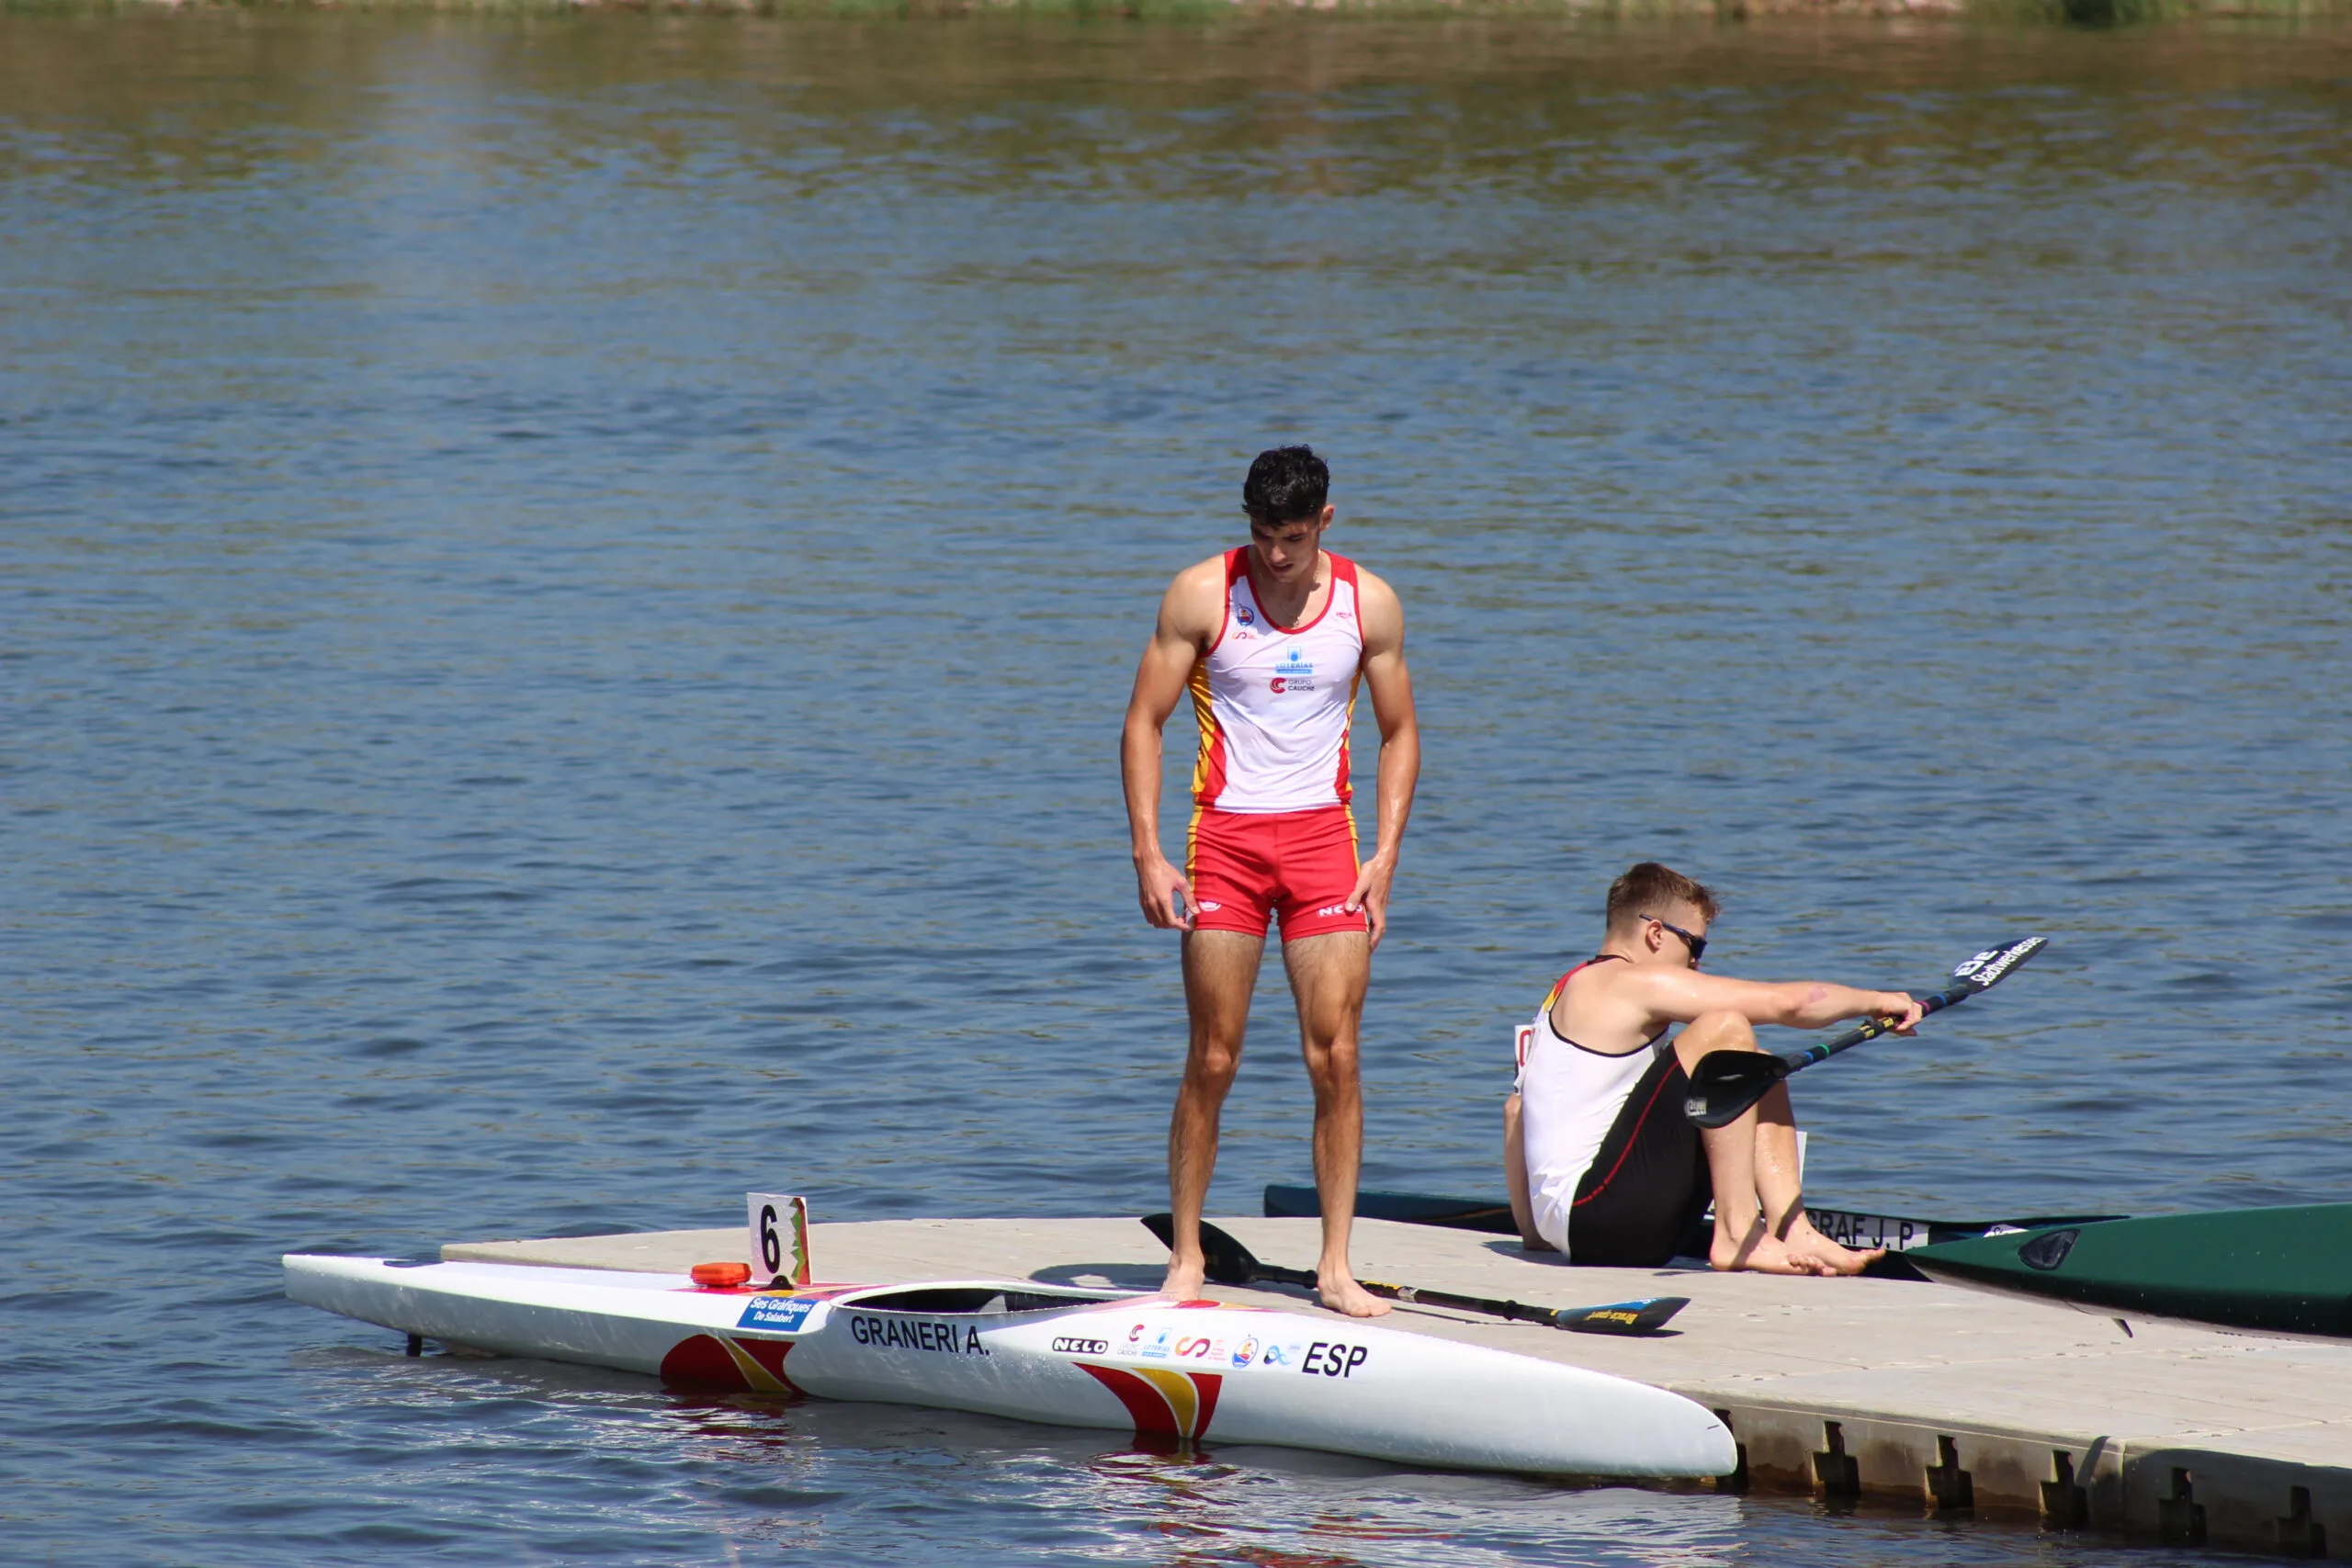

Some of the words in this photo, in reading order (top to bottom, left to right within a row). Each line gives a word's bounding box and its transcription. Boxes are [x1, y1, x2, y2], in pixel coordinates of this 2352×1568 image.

[760, 1204, 780, 1274] 6
[1872, 1219, 1890, 1249] J.
[750, 1297, 769, 1309] Ses
[753, 1311, 765, 1321] De
[764, 1312, 794, 1323] Salabert
[851, 1315, 959, 1353] GRANERI
[967, 1325, 989, 1355] A.
[1054, 1337, 1108, 1353] NELO
[1302, 1342, 1368, 1379] ESP
